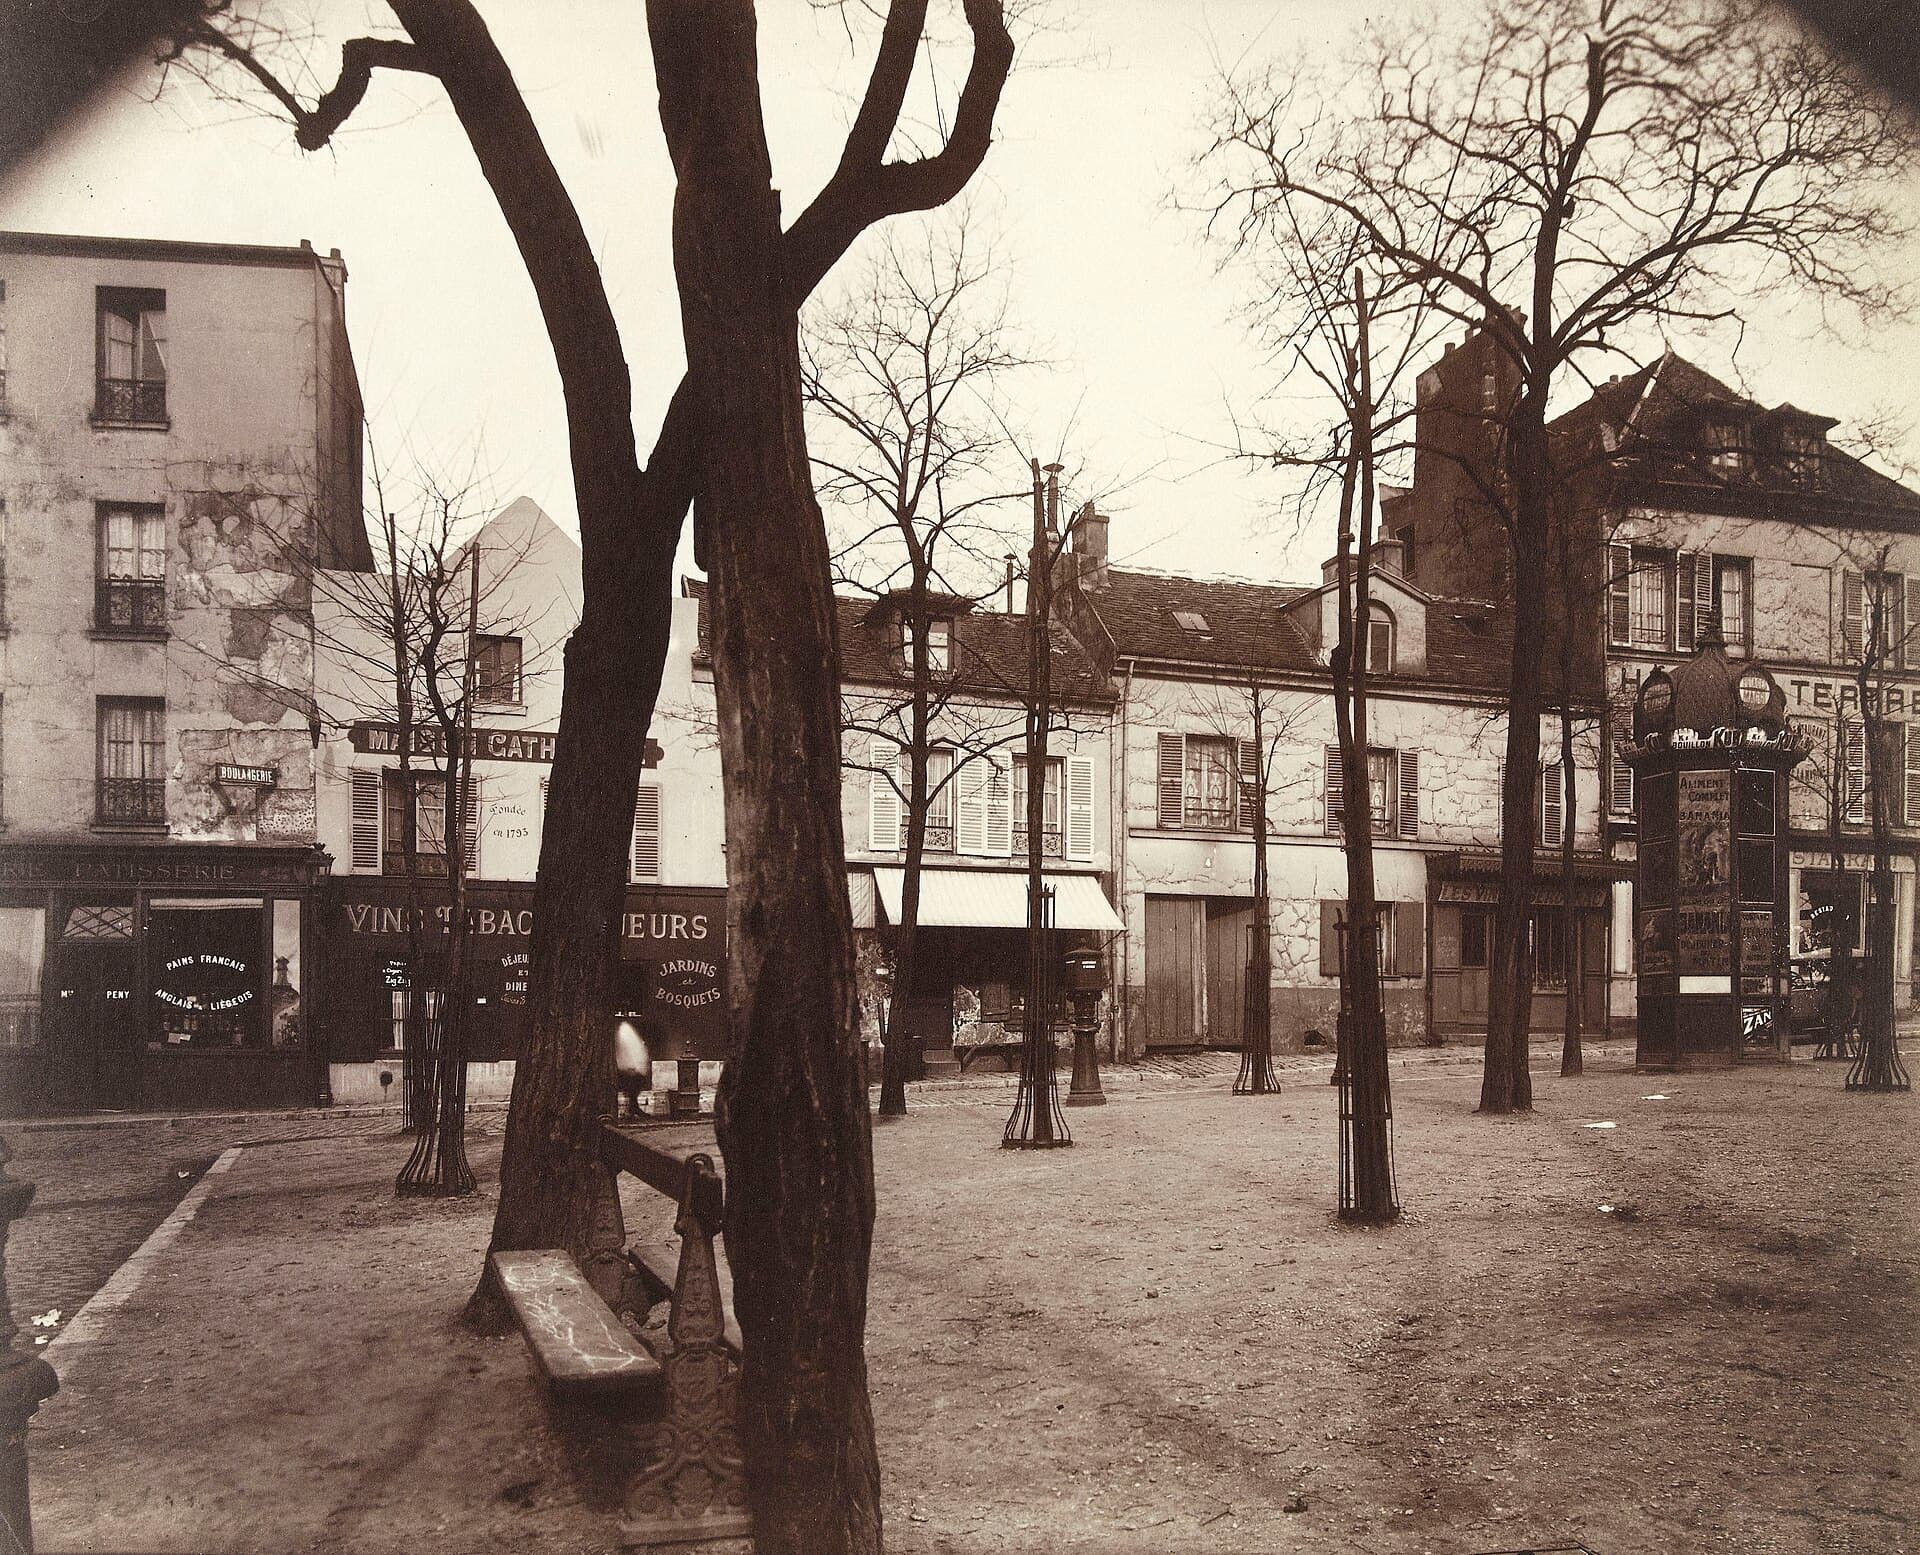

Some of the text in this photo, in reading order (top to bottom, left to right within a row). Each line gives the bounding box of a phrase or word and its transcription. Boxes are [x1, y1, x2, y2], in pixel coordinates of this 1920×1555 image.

[221, 766, 273, 782] BOULANGERIE
[166, 956, 195, 971] PAINS
[501, 953, 529, 967] DÉJEU
[659, 959, 717, 978] JARDINS
[106, 990, 130, 999] PENY
[154, 988, 193, 1010] ANGLAIS
[655, 987, 721, 1009] BOSQUETS
[1743, 1011, 1772, 1036] ZAN
